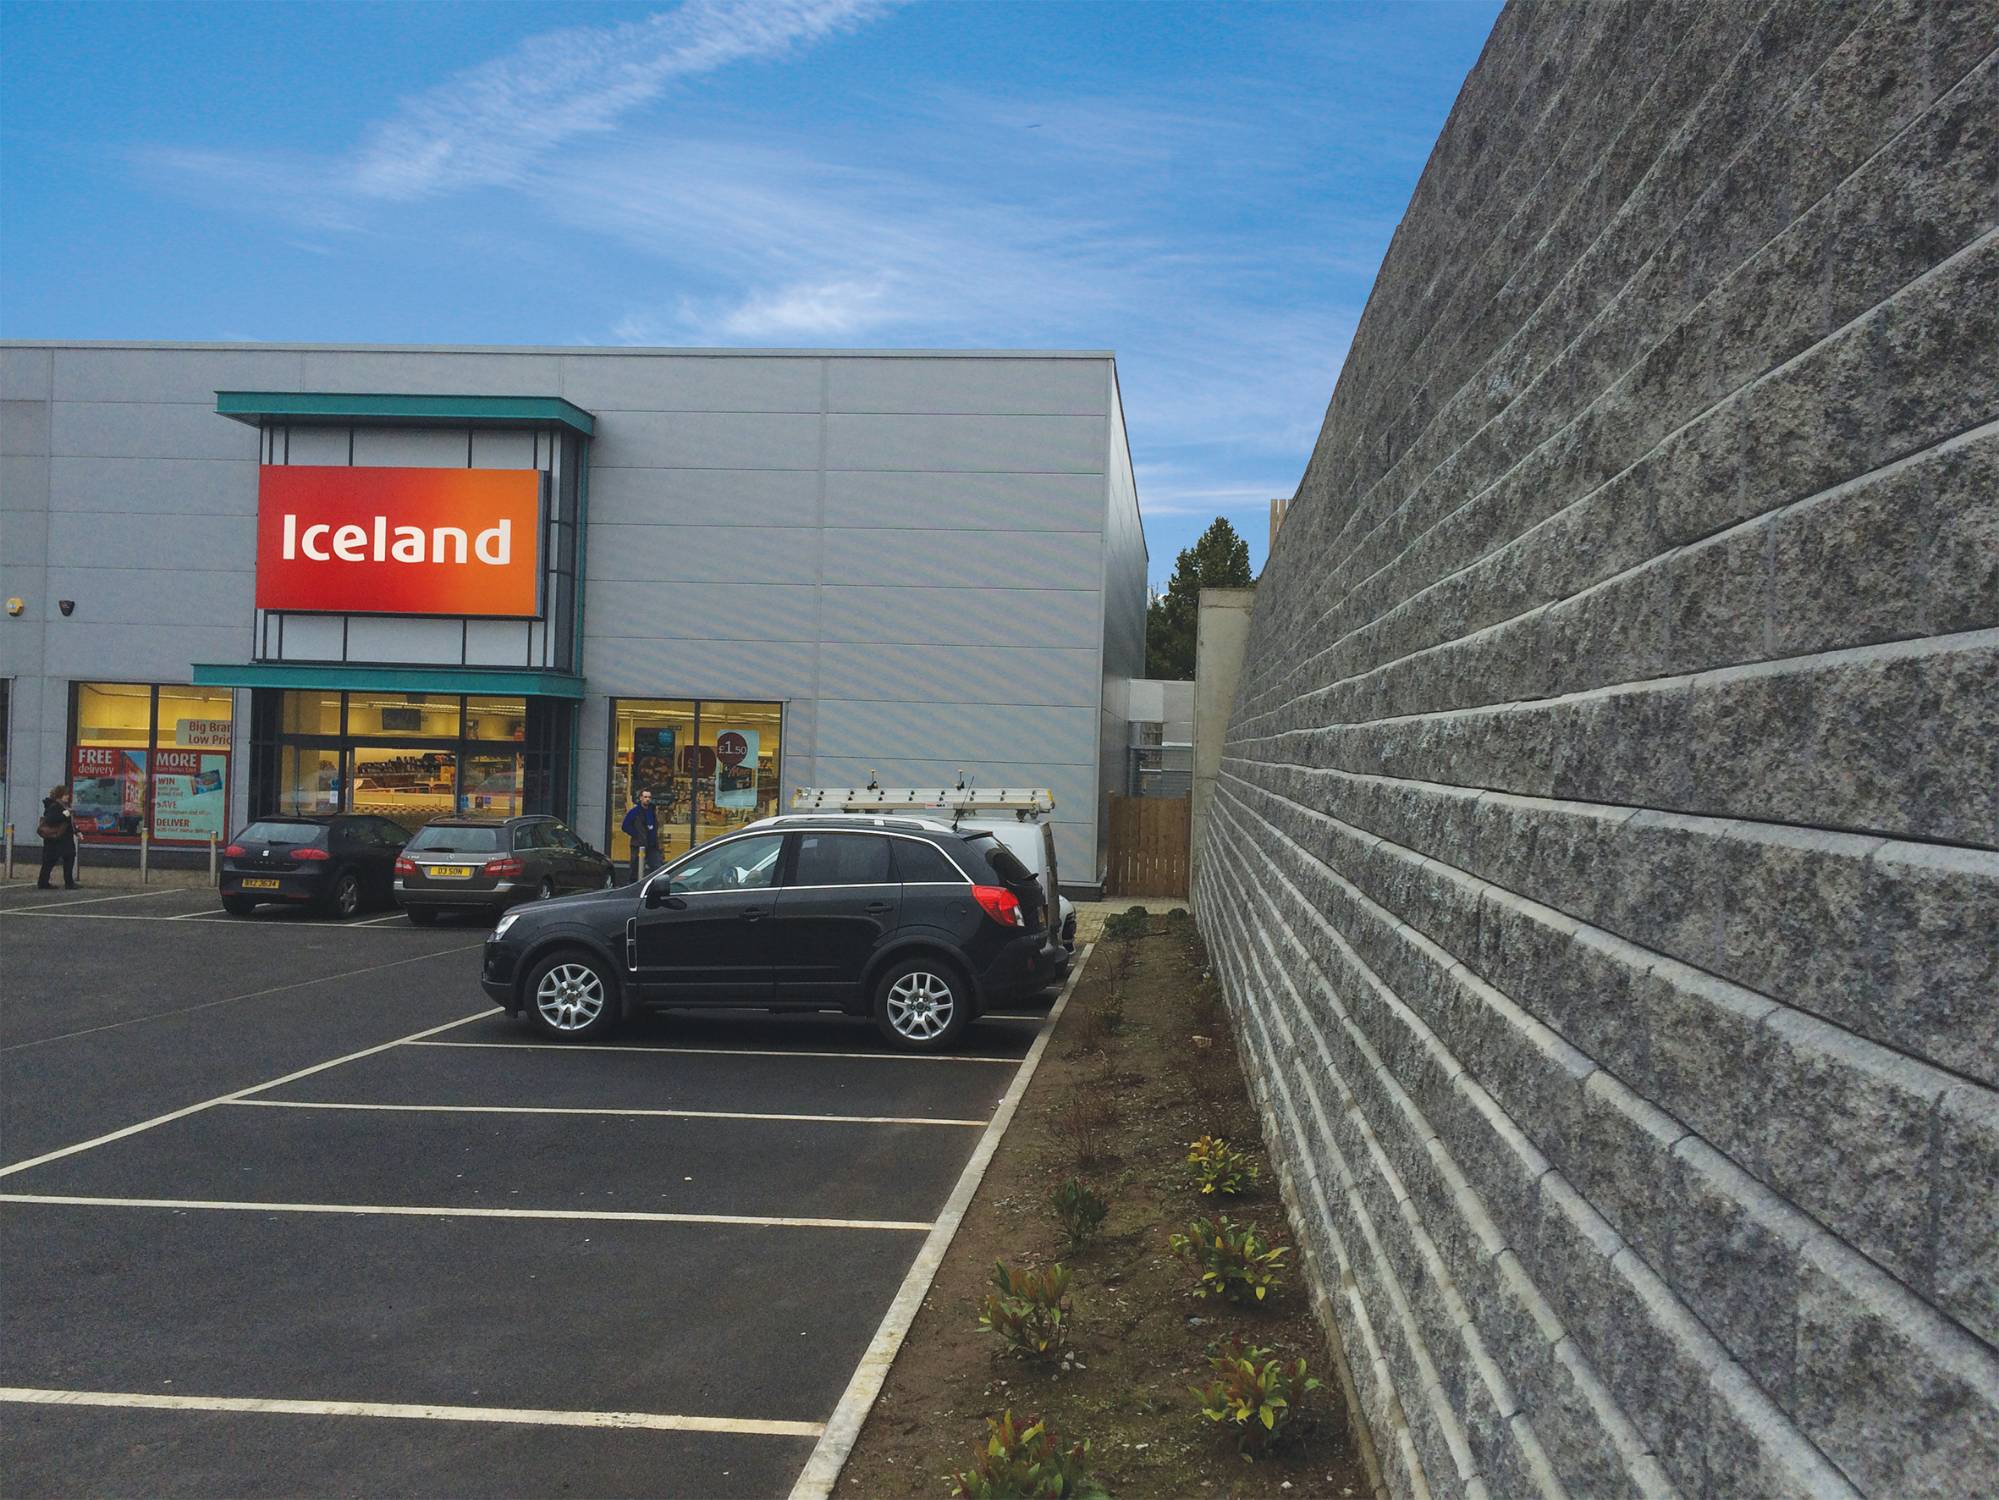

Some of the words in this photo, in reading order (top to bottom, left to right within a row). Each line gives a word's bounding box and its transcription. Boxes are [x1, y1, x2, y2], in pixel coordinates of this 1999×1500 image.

[282, 514, 512, 566] Iceland
[189, 721, 206, 735] Big
[189, 734, 210, 744] Low
[78, 749, 113, 765] FREE
[156, 752, 197, 768] MORE
[78, 763, 114, 777] delivery
[157, 777, 176, 785] WIN
[156, 800, 177, 809] SAVE
[156, 818, 190, 828] DELIVER
